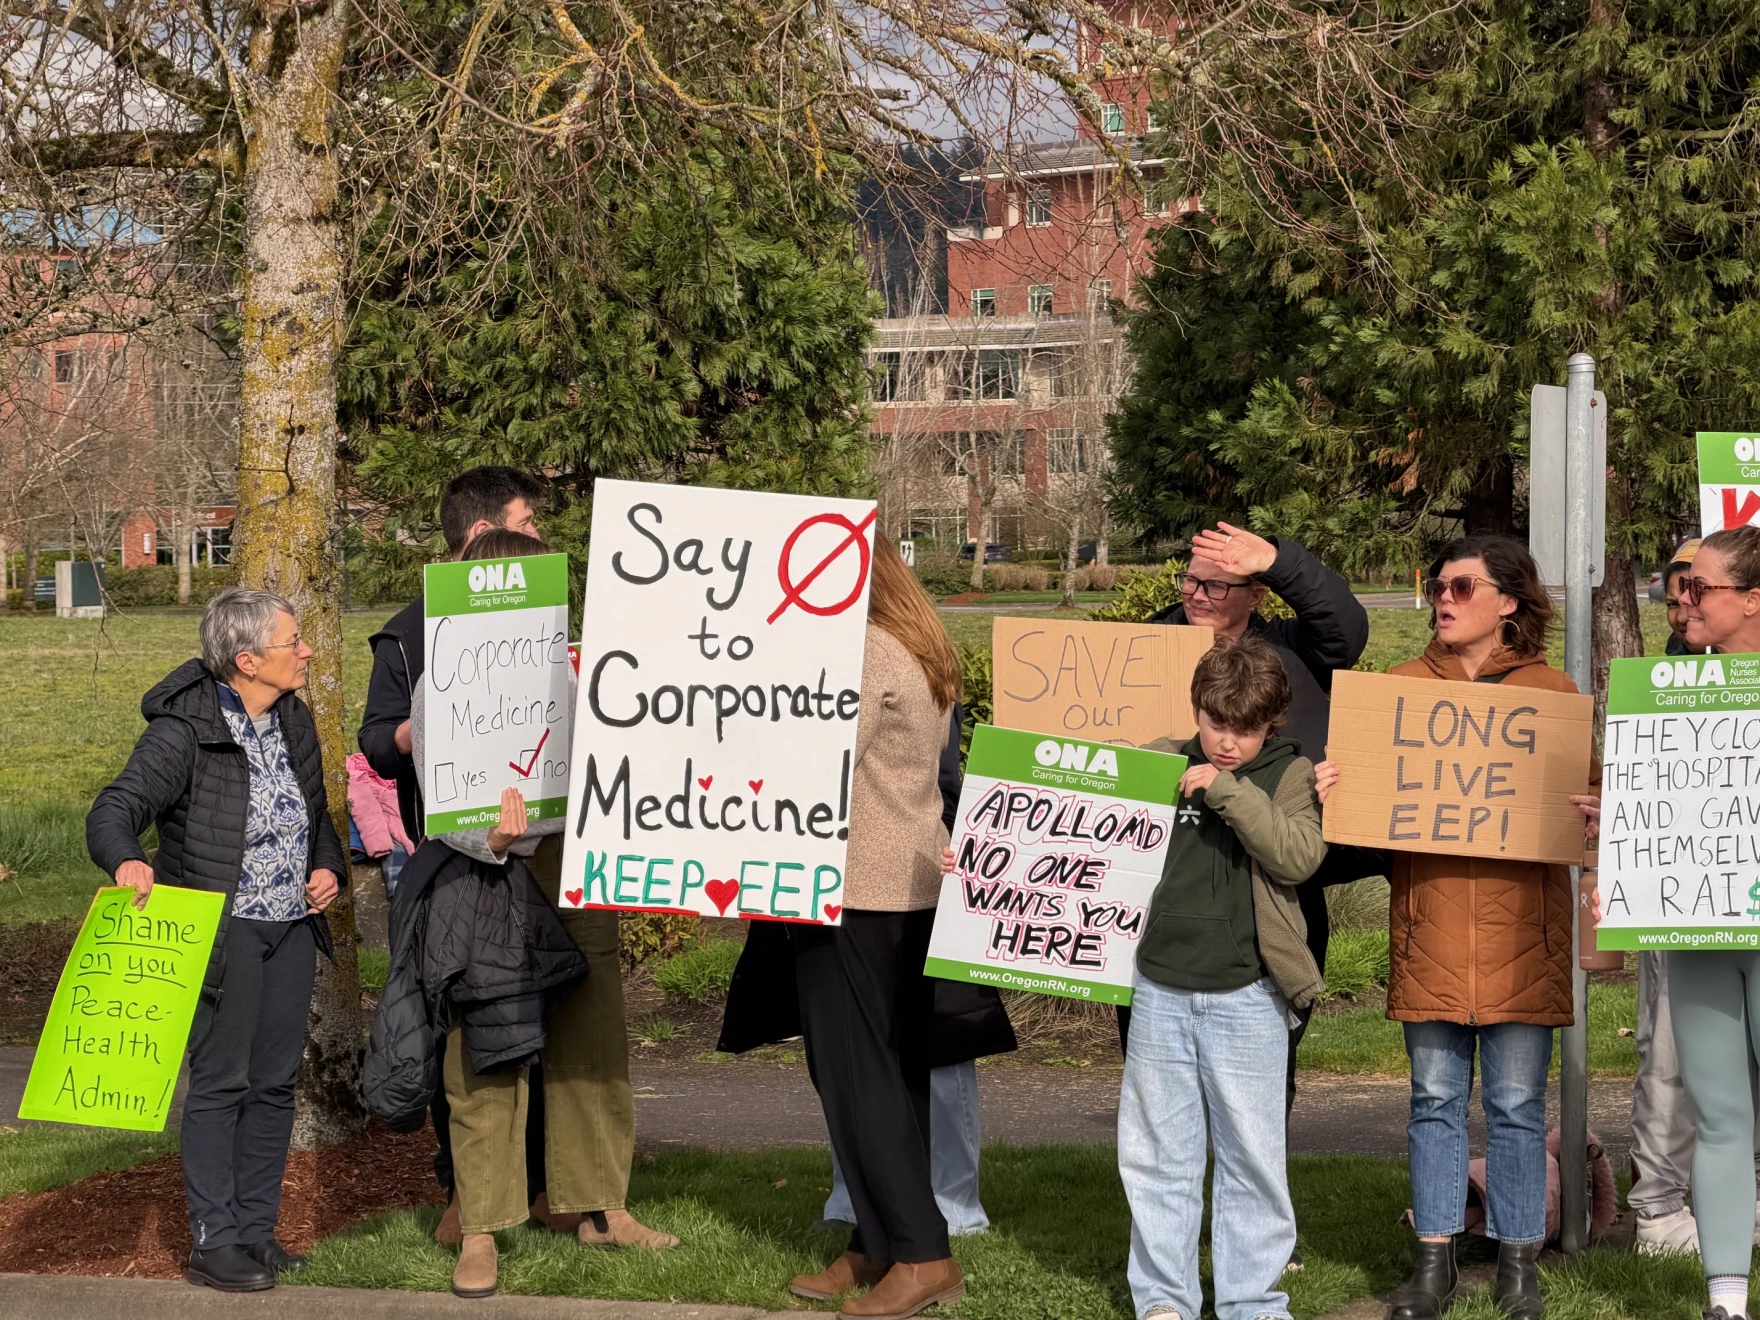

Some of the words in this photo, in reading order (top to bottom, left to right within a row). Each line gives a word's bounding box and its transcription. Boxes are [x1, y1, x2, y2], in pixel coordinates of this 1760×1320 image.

[468, 562, 527, 593] ONA
[611, 502, 753, 611] Say
[470, 597, 491, 607] Caring
[492, 595, 501, 605] for
[502, 594, 526, 605] Oregon
[431, 616, 565, 695] Corporate
[687, 615, 754, 661] to
[1003, 630, 1162, 702] SAVE
[1650, 659, 1727, 689] ONA
[1729, 668, 1758, 677] Nurses
[1730, 658, 1759, 669] Oregon
[451, 693, 563, 741] Medicine
[588, 649, 860, 744] Corporate
[1655, 692, 1696, 708] Caring
[1699, 691, 1717, 704] for
[1393, 696, 1539, 755] LONG
[461, 769, 487, 800] yes
[543, 758, 567, 778] no
[1032, 769, 1063, 783] Caring
[1065, 774, 1079, 784] for
[1080, 777, 1115, 790] Oregon
[1034, 740, 1119, 777] ONA
[1397, 755, 1516, 799] LIVE
[1603, 762, 1644, 791] THE
[576, 748, 851, 841] Medicine!
[1388, 803, 1509, 852] EEP!
[1611, 800, 1674, 834] AND
[957, 836, 1012, 880] NO
[1027, 854, 1106, 890] ONE
[583, 850, 704, 906] KEEP
[737, 859, 842, 920] EEP
[1606, 879, 1631, 916] A
[94, 901, 203, 944] Shame
[963, 879, 1063, 918] WANTS
[1080, 900, 1142, 935] YOU
[990, 919, 1103, 967] HERE
[1638, 931, 1758, 947] www.OregonRN.org
[79, 951, 112, 970] on
[123, 953, 177, 984] you
[969, 967, 1091, 997] www.OregonRN.org
[63, 1025, 161, 1065] Health
